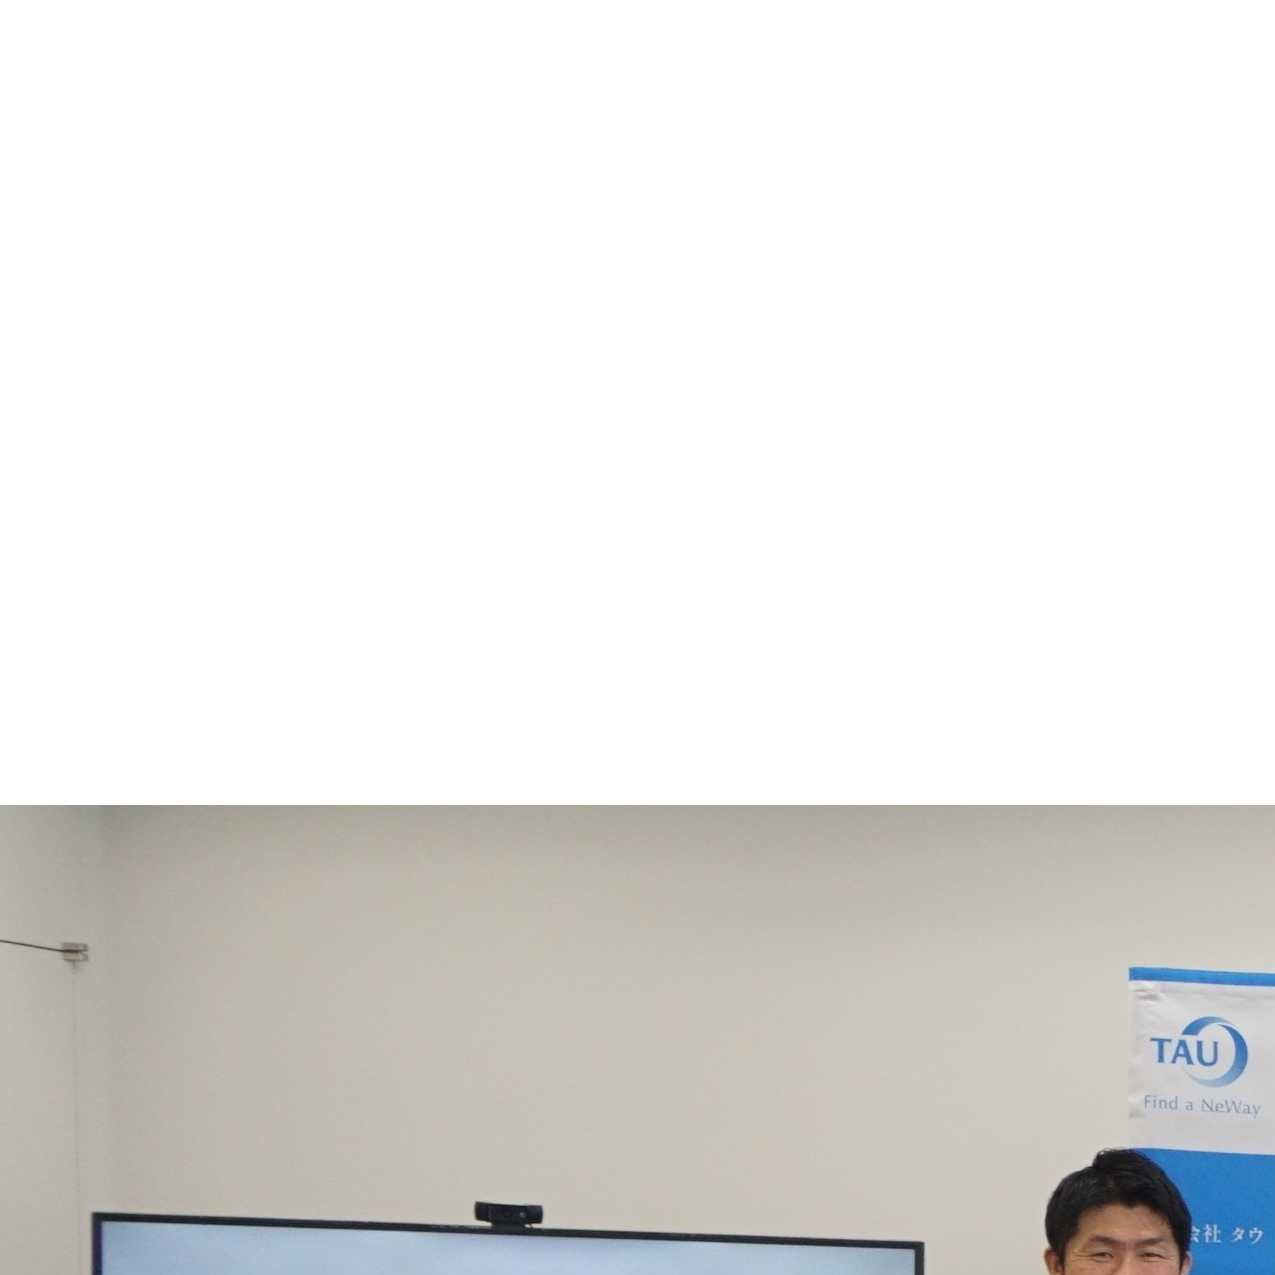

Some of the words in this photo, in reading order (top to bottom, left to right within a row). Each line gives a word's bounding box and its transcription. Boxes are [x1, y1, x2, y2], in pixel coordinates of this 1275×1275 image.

[1149, 1037, 1219, 1068] TAU
[1143, 1094, 1179, 1111] Find
[1185, 1101, 1194, 1112] a
[1201, 1098, 1261, 1119] NeWay
[1192, 1223, 1221, 1244] 会社
[1231, 1226, 1264, 1244] タウ
